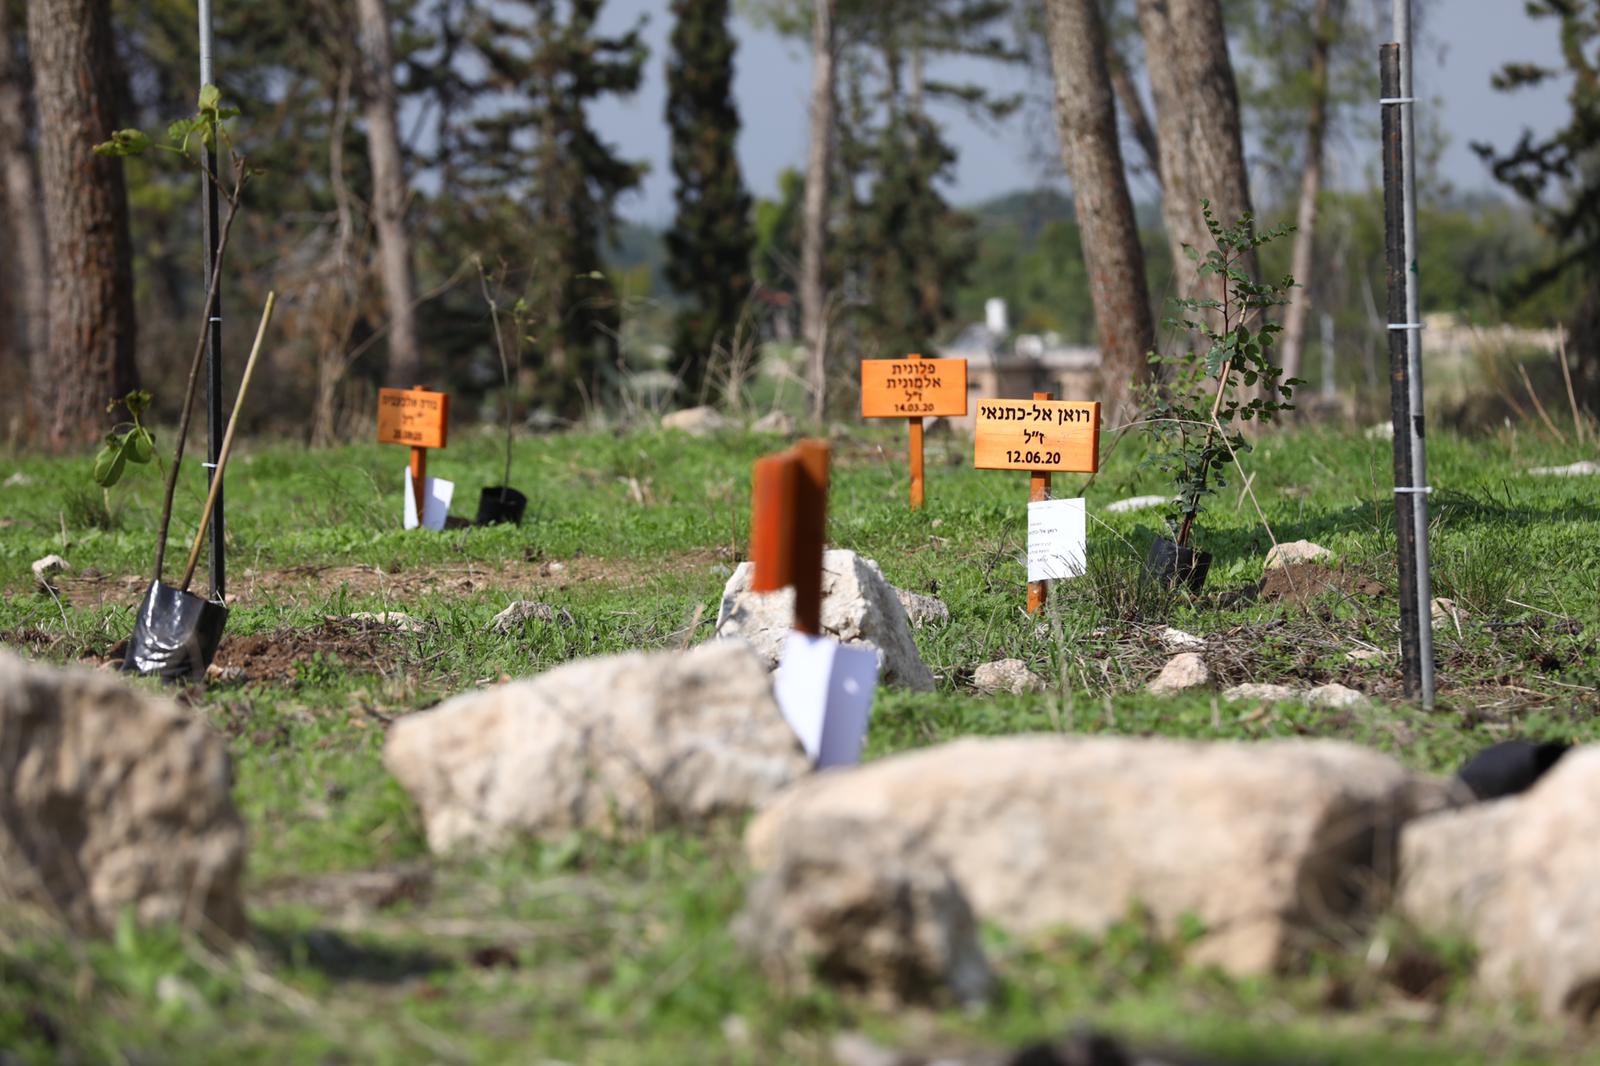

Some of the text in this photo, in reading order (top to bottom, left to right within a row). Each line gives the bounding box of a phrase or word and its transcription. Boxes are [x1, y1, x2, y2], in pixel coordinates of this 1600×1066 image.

[892, 362, 936, 375] פלונית
[886, 375, 941, 388] אלמונית
[895, 404, 934, 412] 14.03.20
[981, 404, 1090, 425] רואן אל-כתנאי
[1006, 451, 1061, 464] 12.06.20
